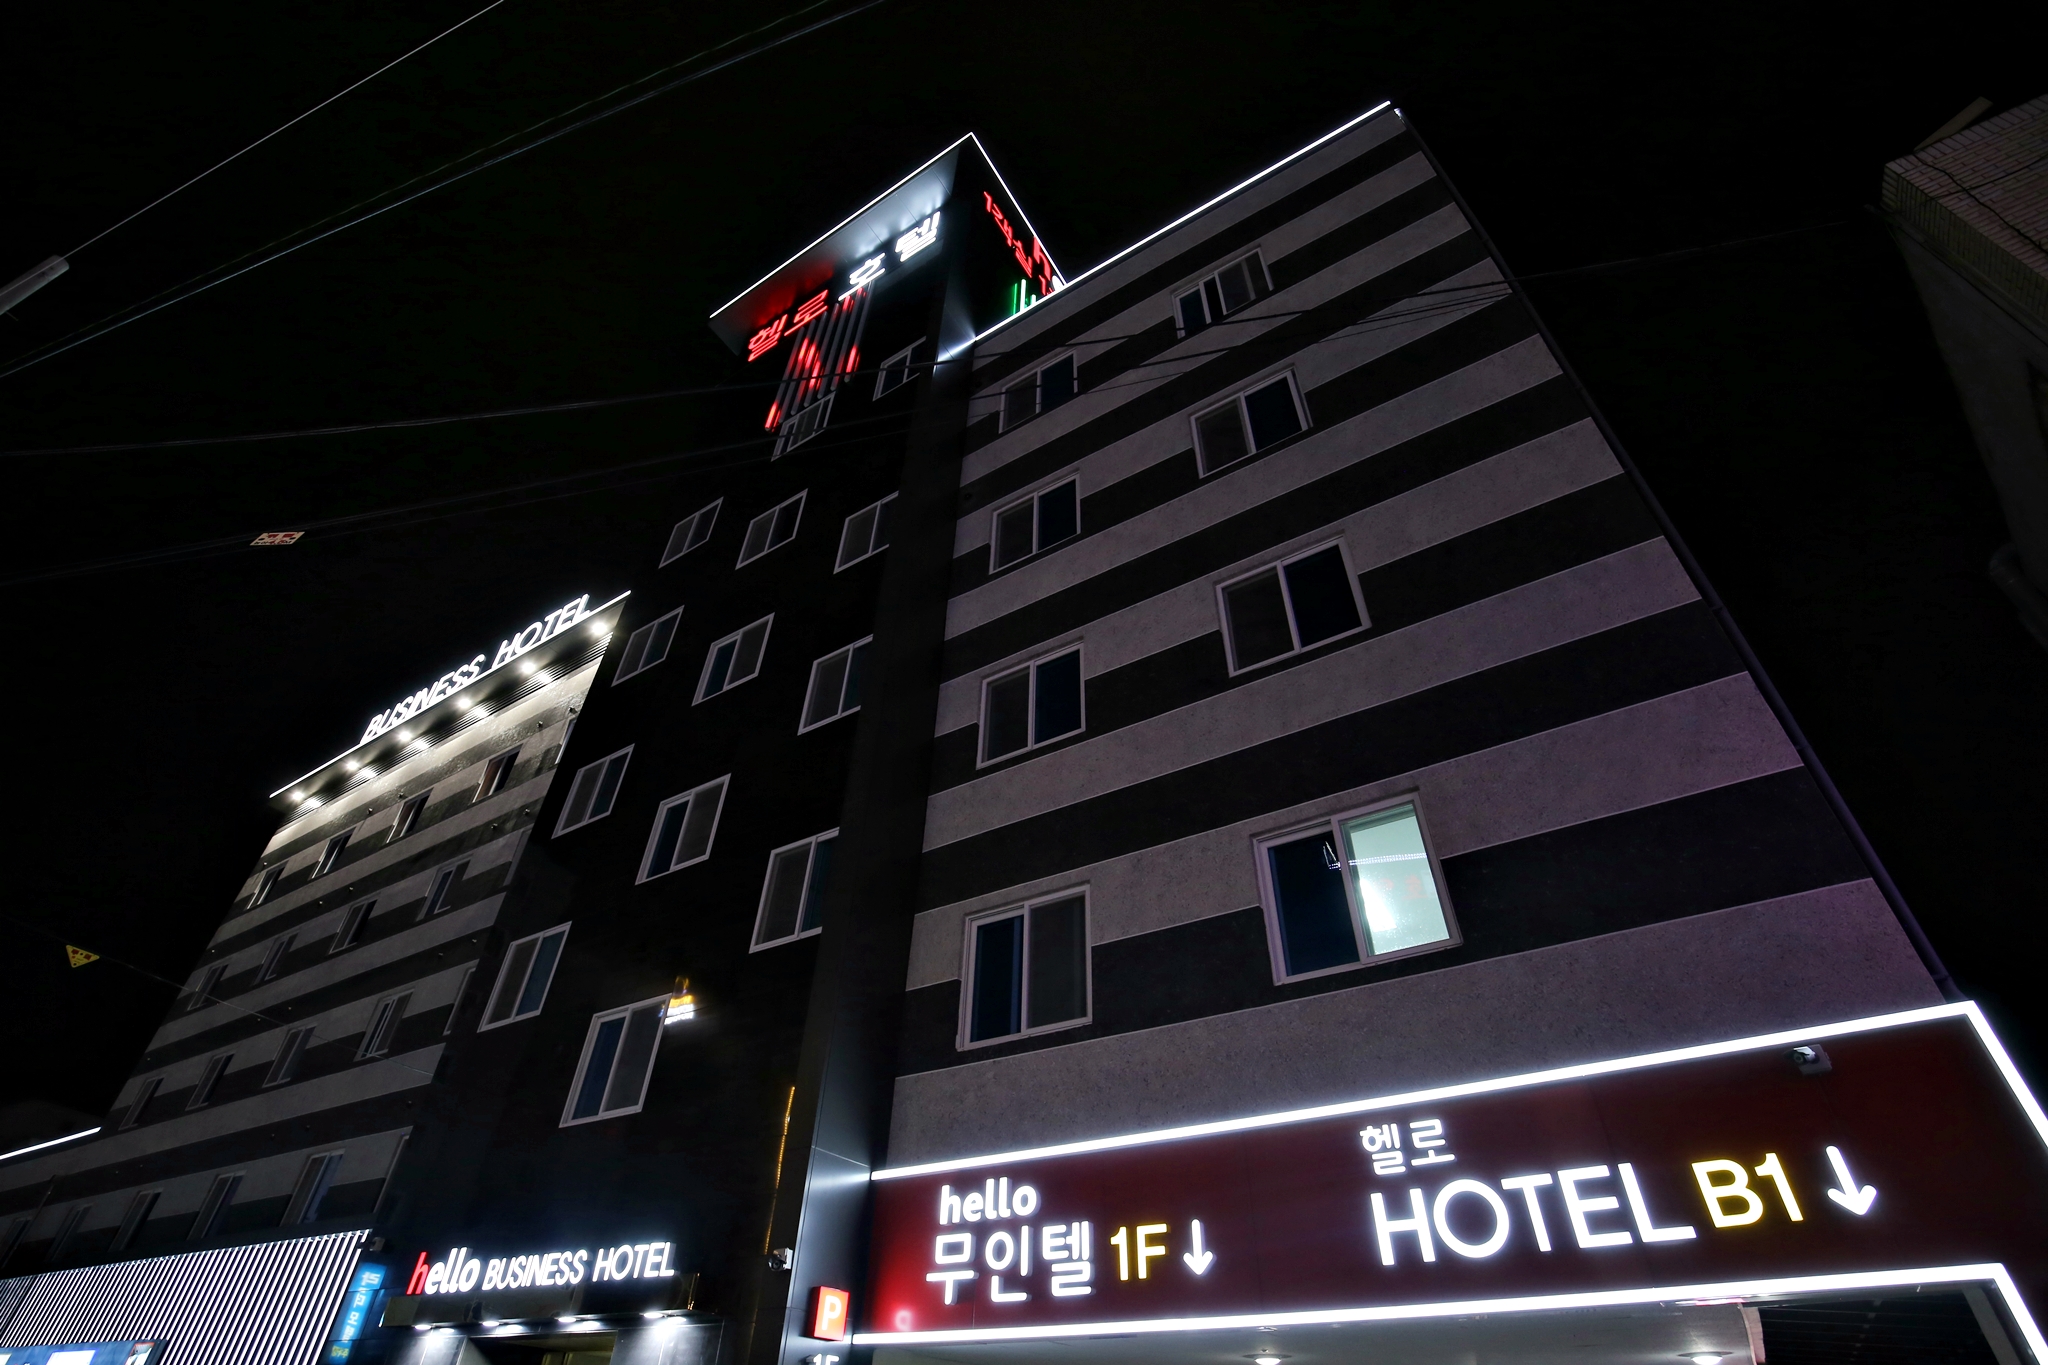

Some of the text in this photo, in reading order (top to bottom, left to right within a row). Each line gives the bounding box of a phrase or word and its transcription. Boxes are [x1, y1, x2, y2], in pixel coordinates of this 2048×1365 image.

[748, 289, 829, 362] 헬로
[838, 211, 941, 301] 호텔
[360, 594, 591, 745] BUSINESS HOTEL
[1359, 1118, 1456, 1176] 헬로
[939, 1176, 1038, 1226] hello
[1369, 1152, 1804, 1266] HOTEL B1
[406, 1241, 676, 1296] hello BUSINESS HOTEL
[925, 1220, 1169, 1306] 무인텔 1F
[821, 1294, 843, 1332] P
